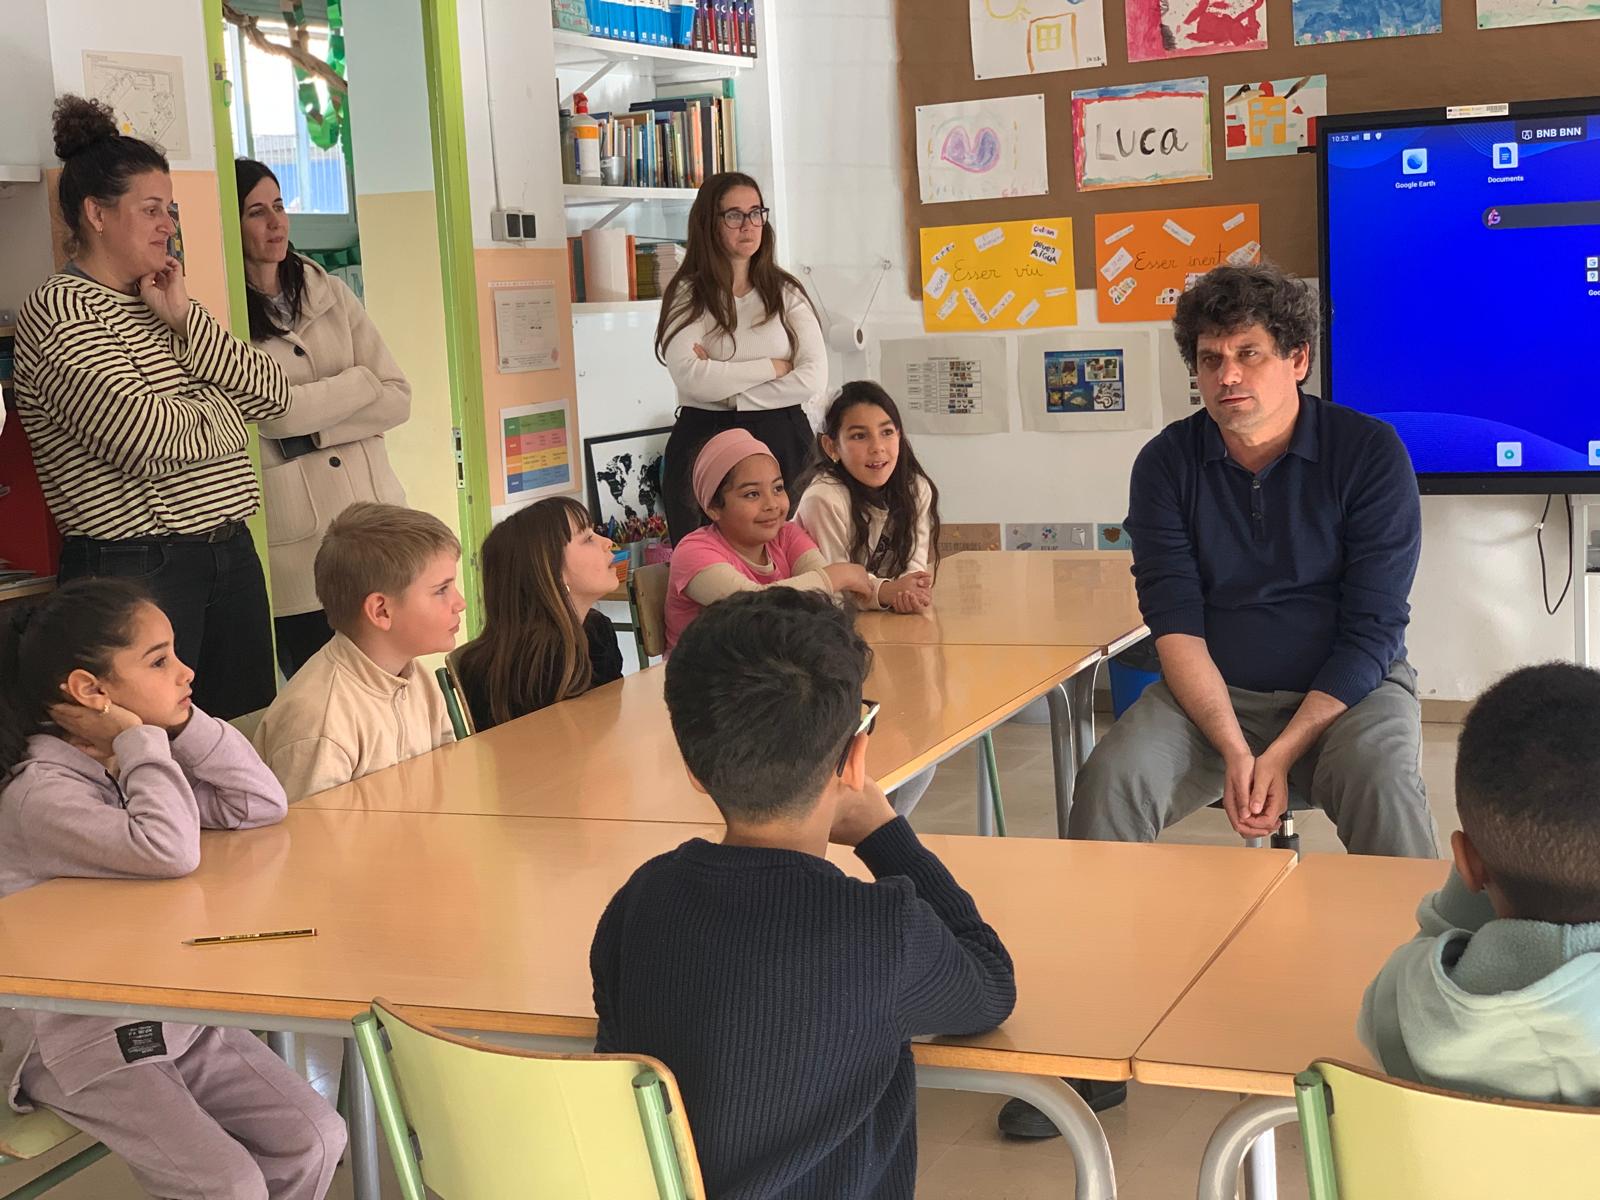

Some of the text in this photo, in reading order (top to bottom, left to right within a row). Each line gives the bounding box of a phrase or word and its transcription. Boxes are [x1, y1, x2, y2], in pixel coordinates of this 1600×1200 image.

[1536, 127, 1582, 138] BNB BNN
[1395, 180, 1436, 189] Google Earth
[1134, 251, 1178, 271] Esser
[1188, 243, 1227, 267] inert
[953, 259, 1044, 282] Esser viu
